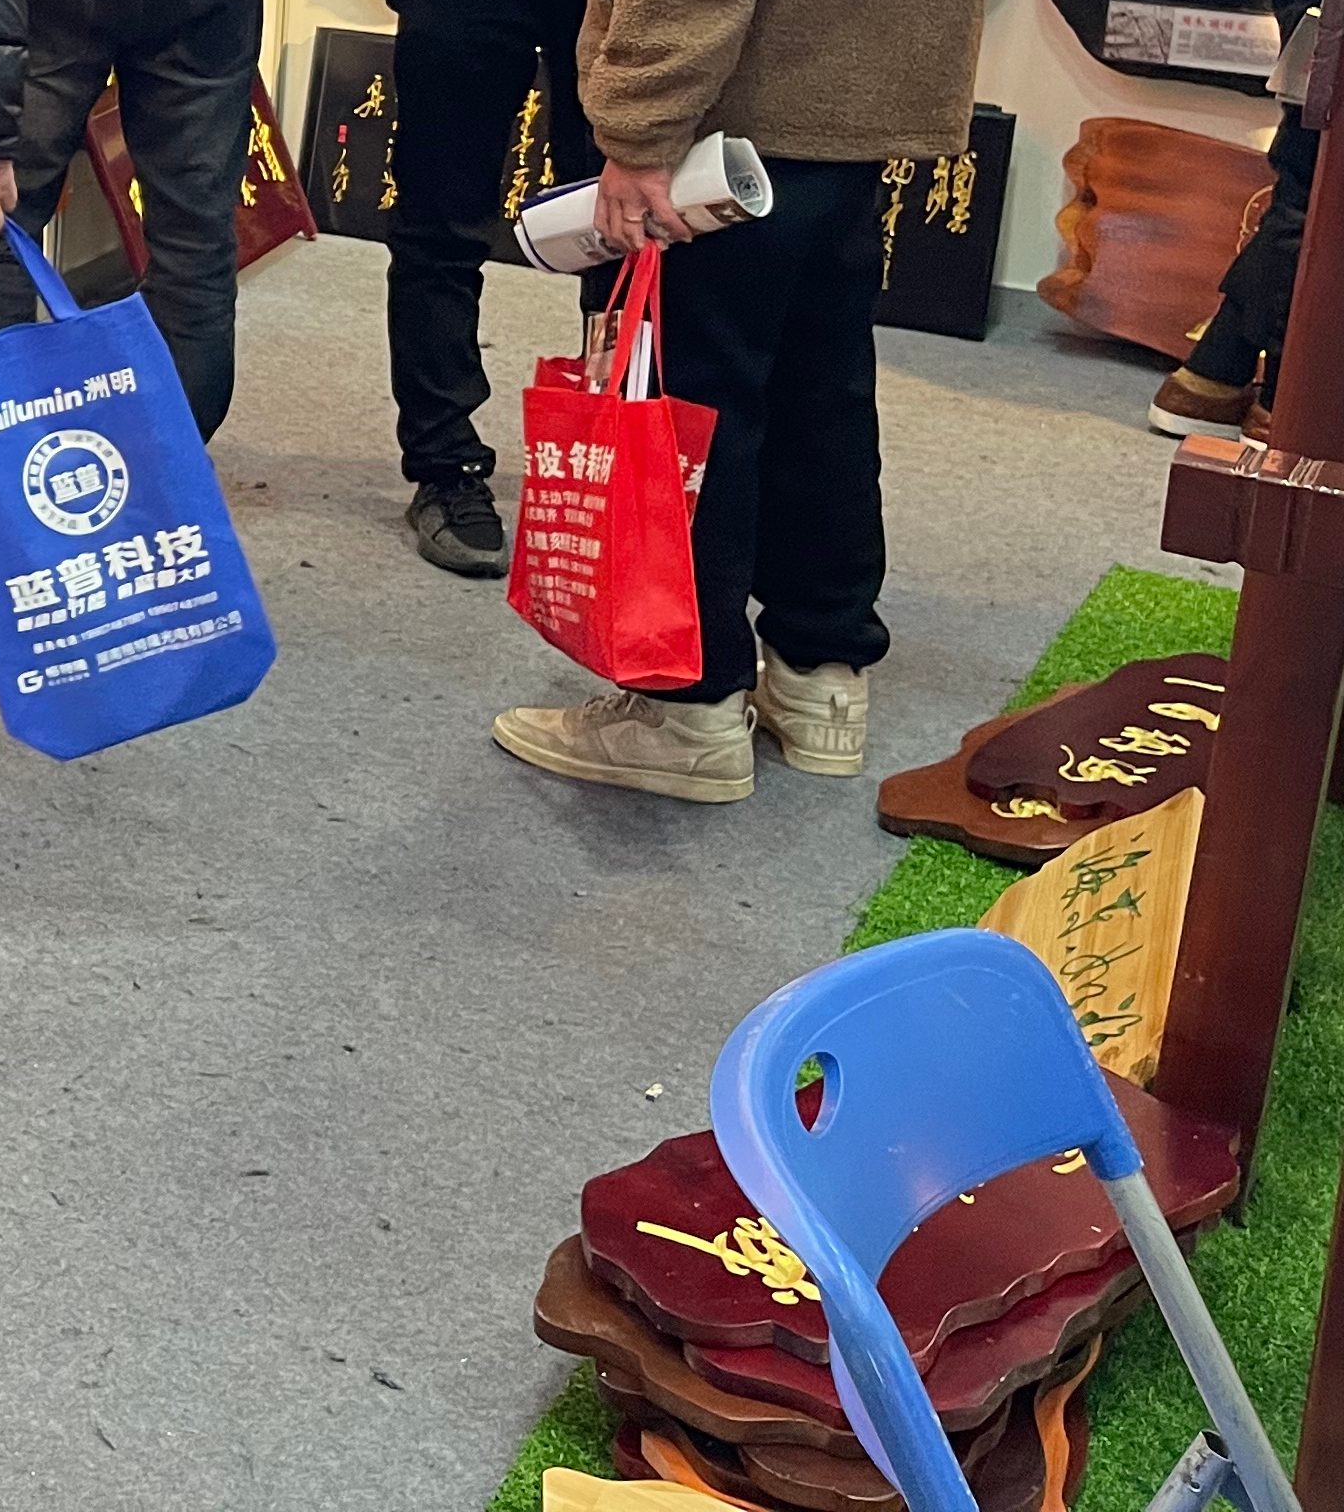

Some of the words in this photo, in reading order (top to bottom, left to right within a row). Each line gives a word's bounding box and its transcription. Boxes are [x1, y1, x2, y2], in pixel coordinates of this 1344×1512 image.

[84, 367, 138, 401] 洲明
[5, 525, 209, 614] 蓝普科技
